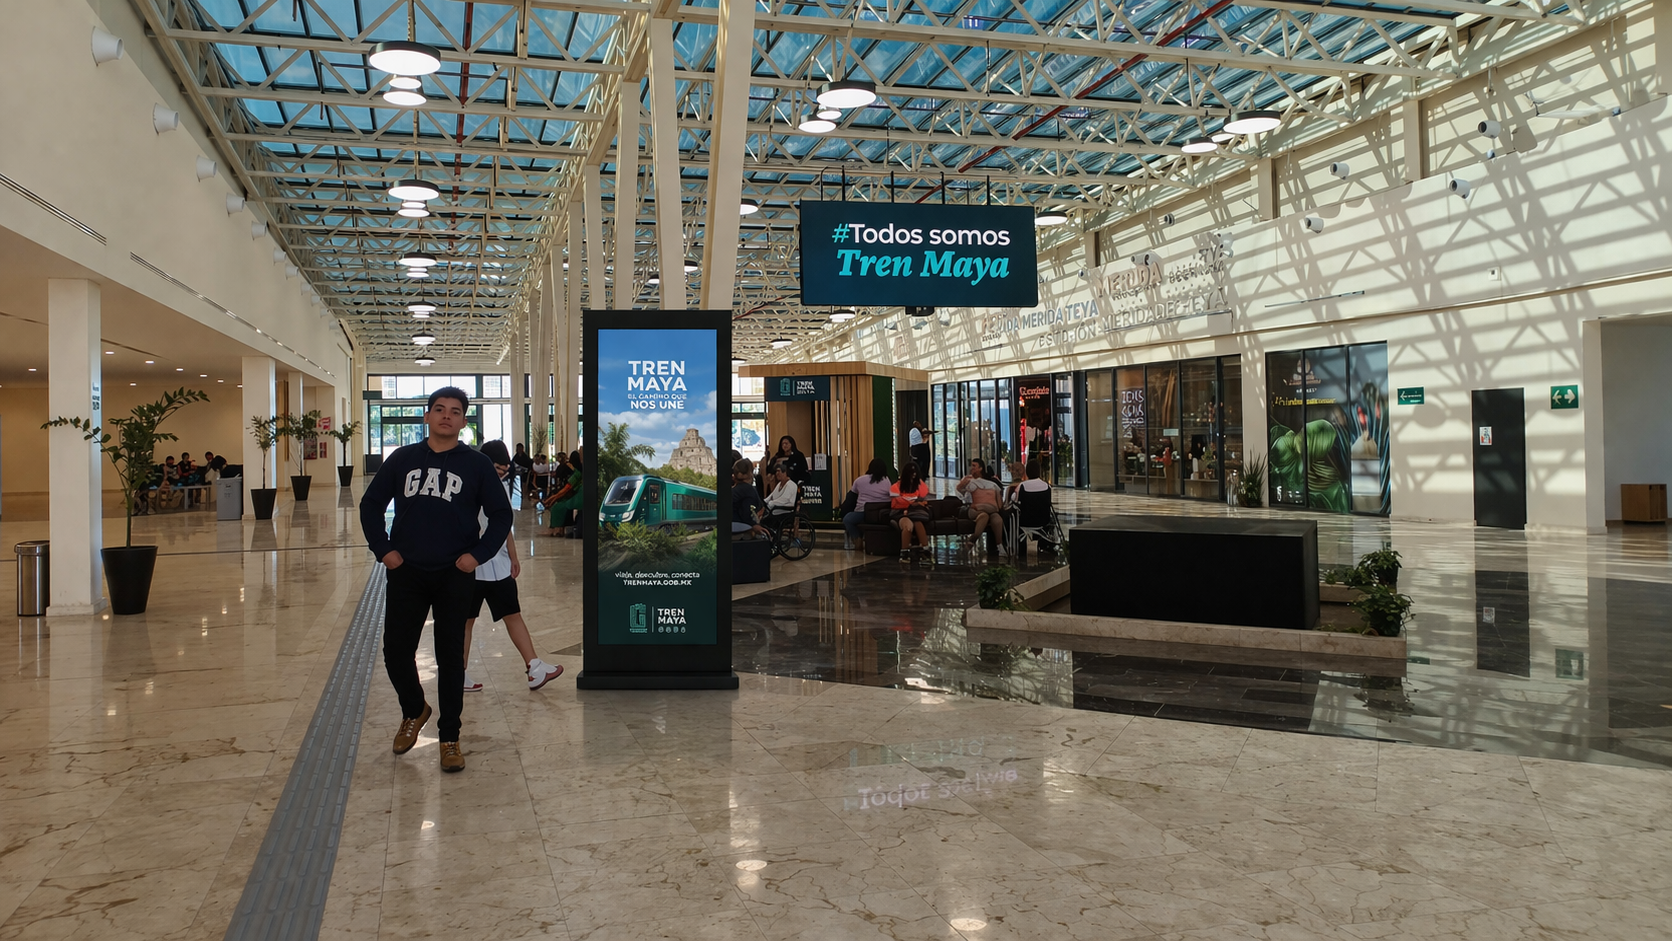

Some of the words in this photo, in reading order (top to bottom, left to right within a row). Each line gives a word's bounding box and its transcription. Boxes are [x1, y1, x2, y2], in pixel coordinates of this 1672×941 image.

[832, 223, 923, 245] #Todos
[929, 228, 1011, 246] somos
[837, 249, 912, 277] Tren
[920, 250, 1010, 286] Maya
[1022, 307, 1063, 330] MERIDA
[1065, 299, 1098, 321] TEYA
[628, 360, 685, 376] TREN
[628, 376, 688, 391] MAYA
[630, 400, 656, 410] NOS
[659, 400, 685, 410] UNE
[404, 467, 463, 502] GAP
[657, 608, 685, 616] TREN
[658, 616, 687, 625] MAYA
